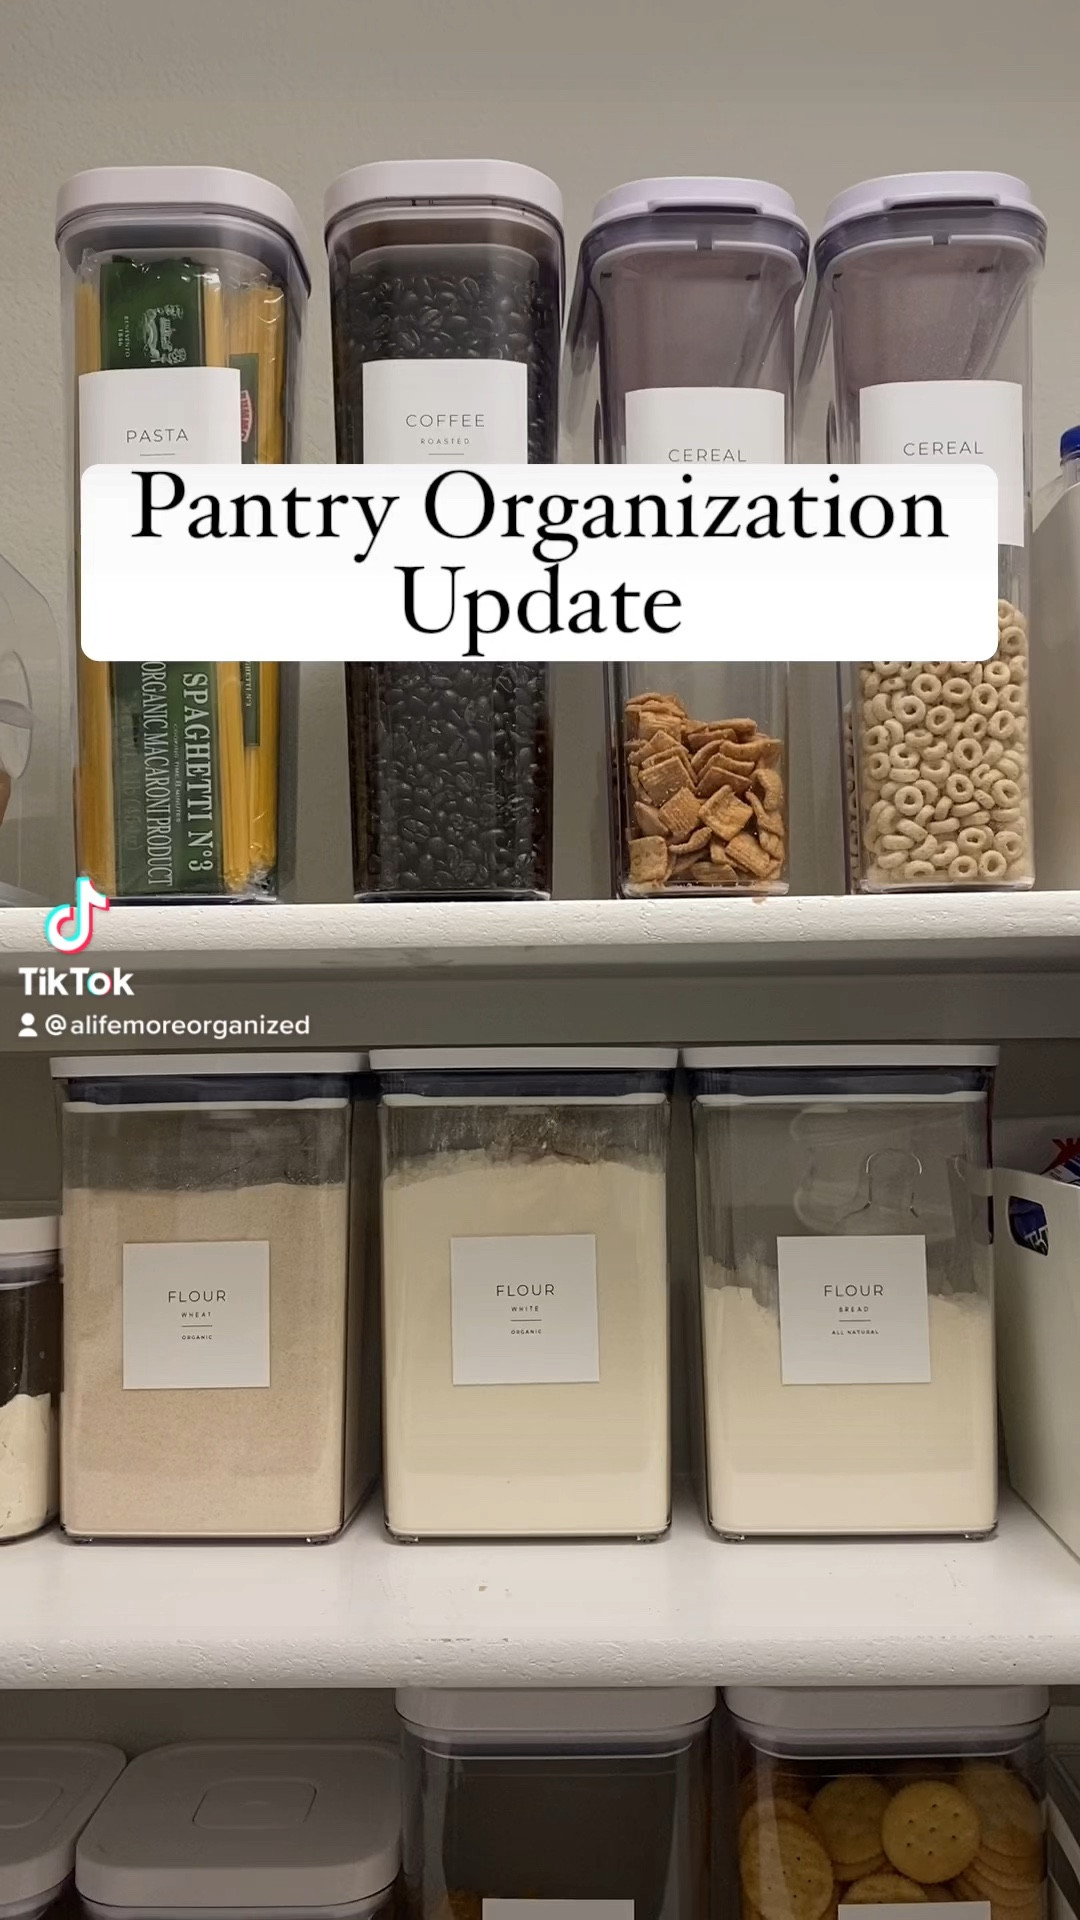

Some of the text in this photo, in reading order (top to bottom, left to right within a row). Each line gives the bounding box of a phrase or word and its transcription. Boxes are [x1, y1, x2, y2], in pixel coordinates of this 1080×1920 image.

[405, 414, 486, 428] COFFEE
[126, 428, 189, 443] PASTA
[420, 437, 470, 445] ROASTED
[668, 448, 747, 463] CEREAL
[903, 441, 985, 457] CEREAL
[183, 673, 213, 822] SPAGHETTI
[141, 661, 173, 887] ORGANIC MACARONI PRODUCT
[168, 1290, 226, 1303] FLOUR
[496, 1284, 555, 1297] FLOUR
[824, 1284, 884, 1297] FLOUR
